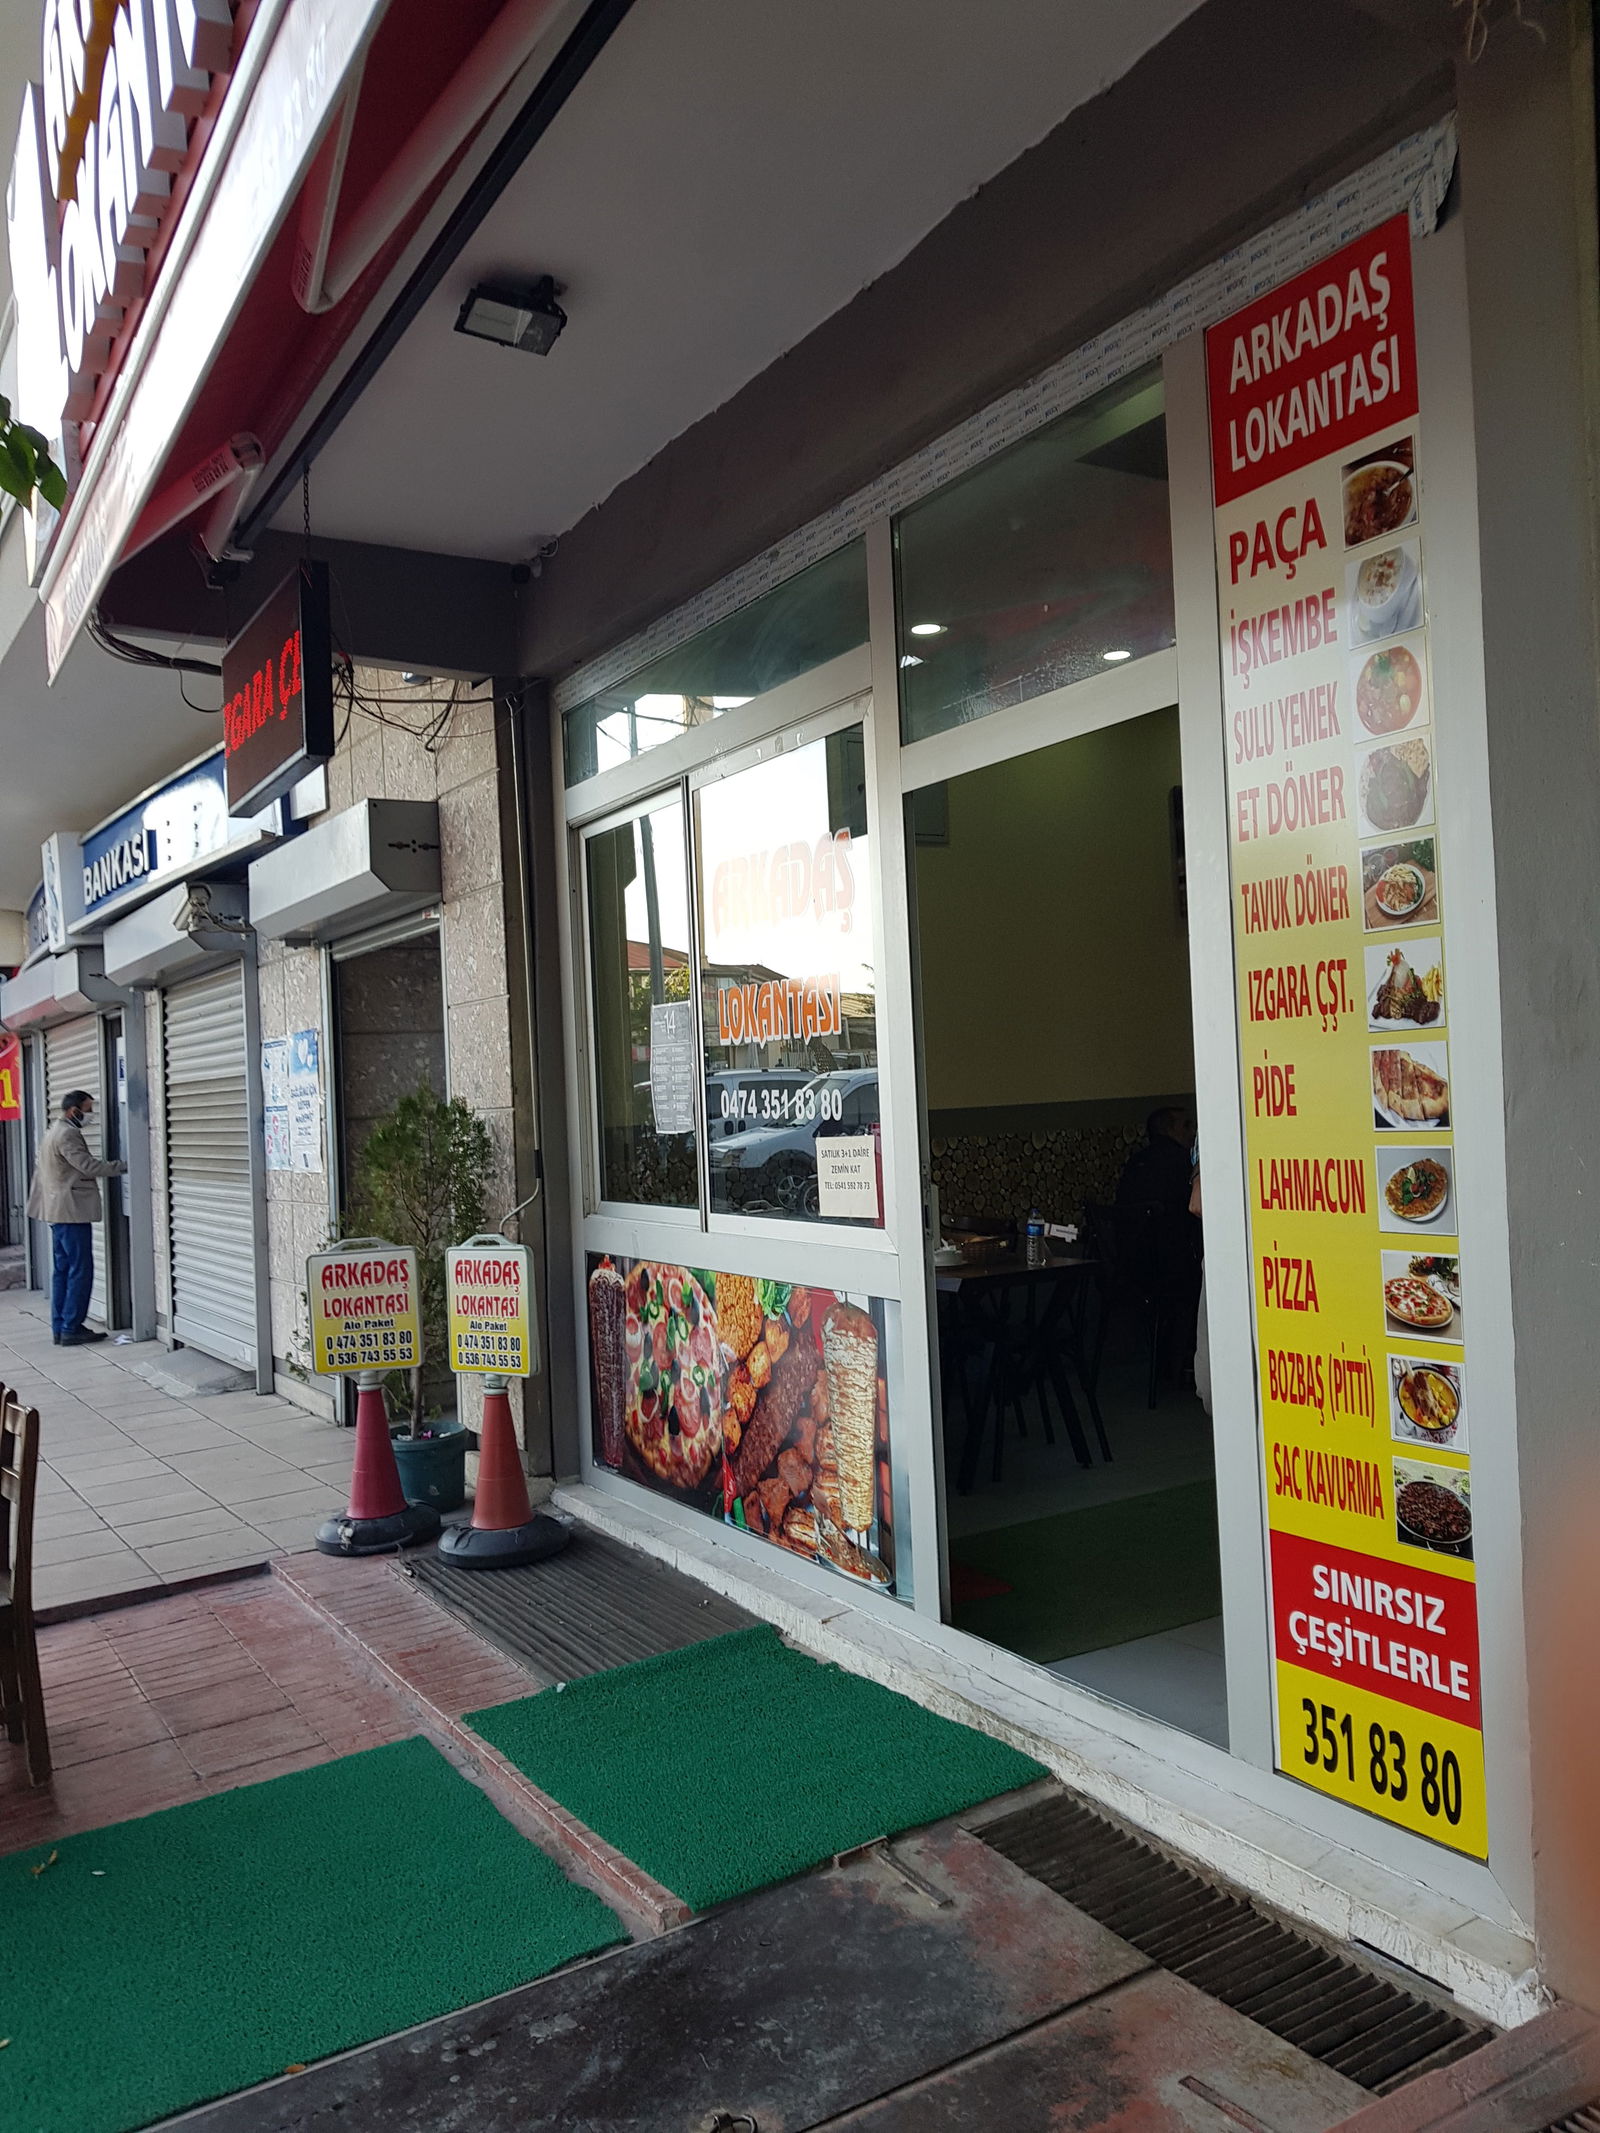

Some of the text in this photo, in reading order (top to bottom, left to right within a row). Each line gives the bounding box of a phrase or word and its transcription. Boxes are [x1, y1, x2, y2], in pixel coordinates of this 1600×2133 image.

[1229, 251, 1392, 393] ARKADAŞ
[1230, 335, 1400, 472] LOKANTASI
[1229, 498, 1328, 584] PAÇA
[1231, 588, 1338, 689] İŞKEMBE
[1234, 681, 1341, 764] SULU YEMEK
[1237, 762, 1346, 842] ET DÖNER
[83, 828, 149, 905] BANKASI
[712, 826, 855, 937] ARKADAŞ
[1242, 854, 1350, 934] TAVUK DÖNER
[664, 1010, 676, 1035] 14
[718, 972, 841, 1049] LOKANTASI
[1249, 958, 1354, 1032] IZGARA ÇŞT.
[721, 1089, 842, 1121] 0474 351 83 80
[1254, 1049, 1297, 1118] PİDE
[821, 1146, 869, 1158] SATILIK 3+1 DAİRE
[831, 1163, 861, 1174] ZEMİN KAT
[1259, 1158, 1366, 1215] LAHMACUN
[321, 1259, 409, 1289] ARKADAŞ
[323, 1293, 409, 1318] LOKANTASI
[455, 1259, 520, 1292] ARKADAŞ
[456, 1295, 519, 1318] LOKANTASI
[1262, 1242, 1320, 1313] PİZZA
[326, 1330, 412, 1350] 0 474 351 83 80
[328, 1348, 412, 1365] 0 536 743 55 53
[344, 1319, 394, 1331] Alo Paket
[457, 1334, 521, 1351] 0 474 351 83 80
[458, 1352, 521, 1368] 0 536 743 55 53
[470, 1321, 507, 1331] Alo Paket
[1269, 1342, 1376, 1428] BOZBAŞ (PİTTİ)
[1274, 1443, 1385, 1520] SAC KAVURMA
[1313, 1564, 1447, 1635] SINIRSIZ
[1289, 1610, 1470, 1702] ÇEŞİTLERLE
[1302, 1698, 1462, 1826] 351 83 80
